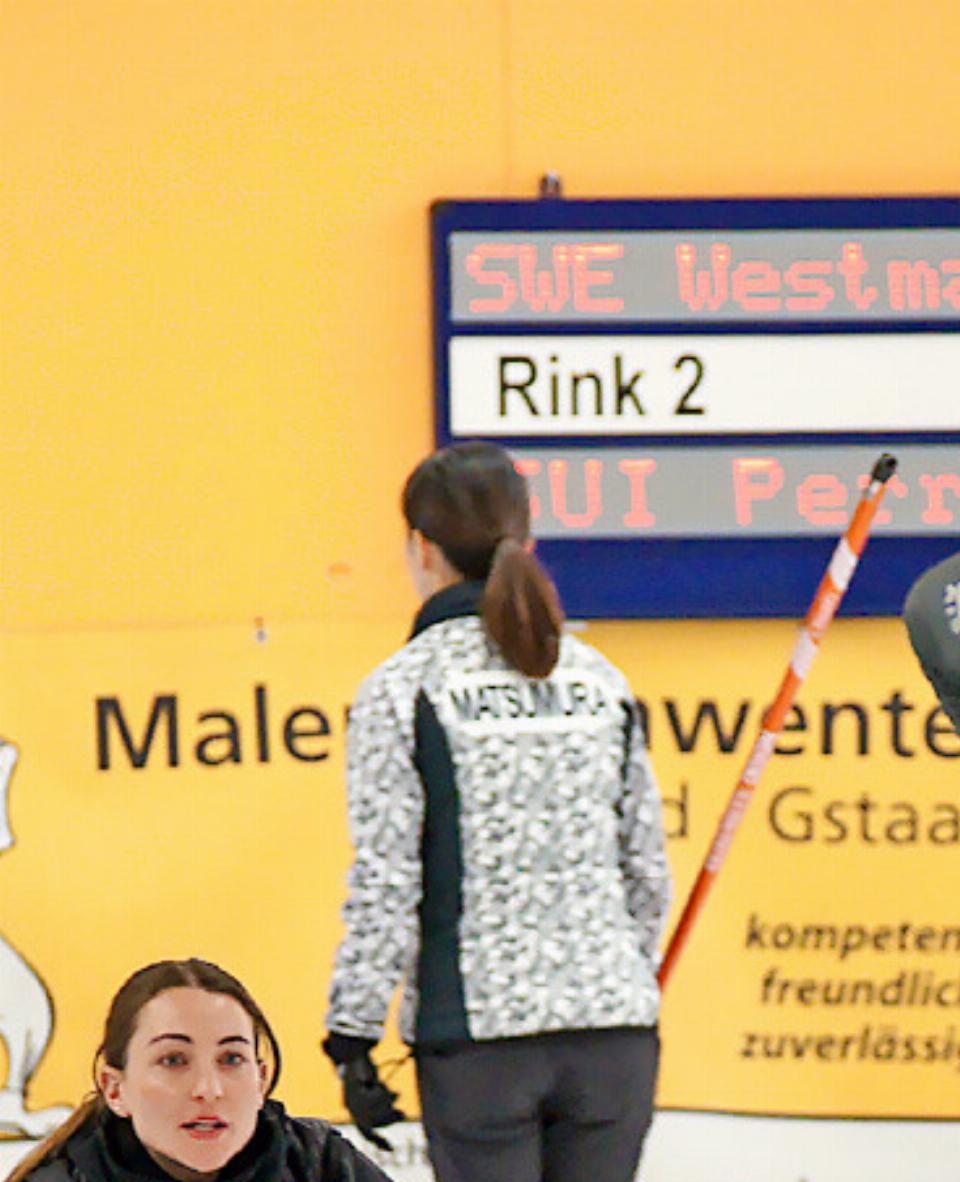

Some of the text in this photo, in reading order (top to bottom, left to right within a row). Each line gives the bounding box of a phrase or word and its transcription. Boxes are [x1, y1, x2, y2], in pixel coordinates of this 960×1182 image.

[466, 242, 625, 314] SWE
[497, 354, 707, 417] Rink 2
[94, 683, 350, 771] Male
